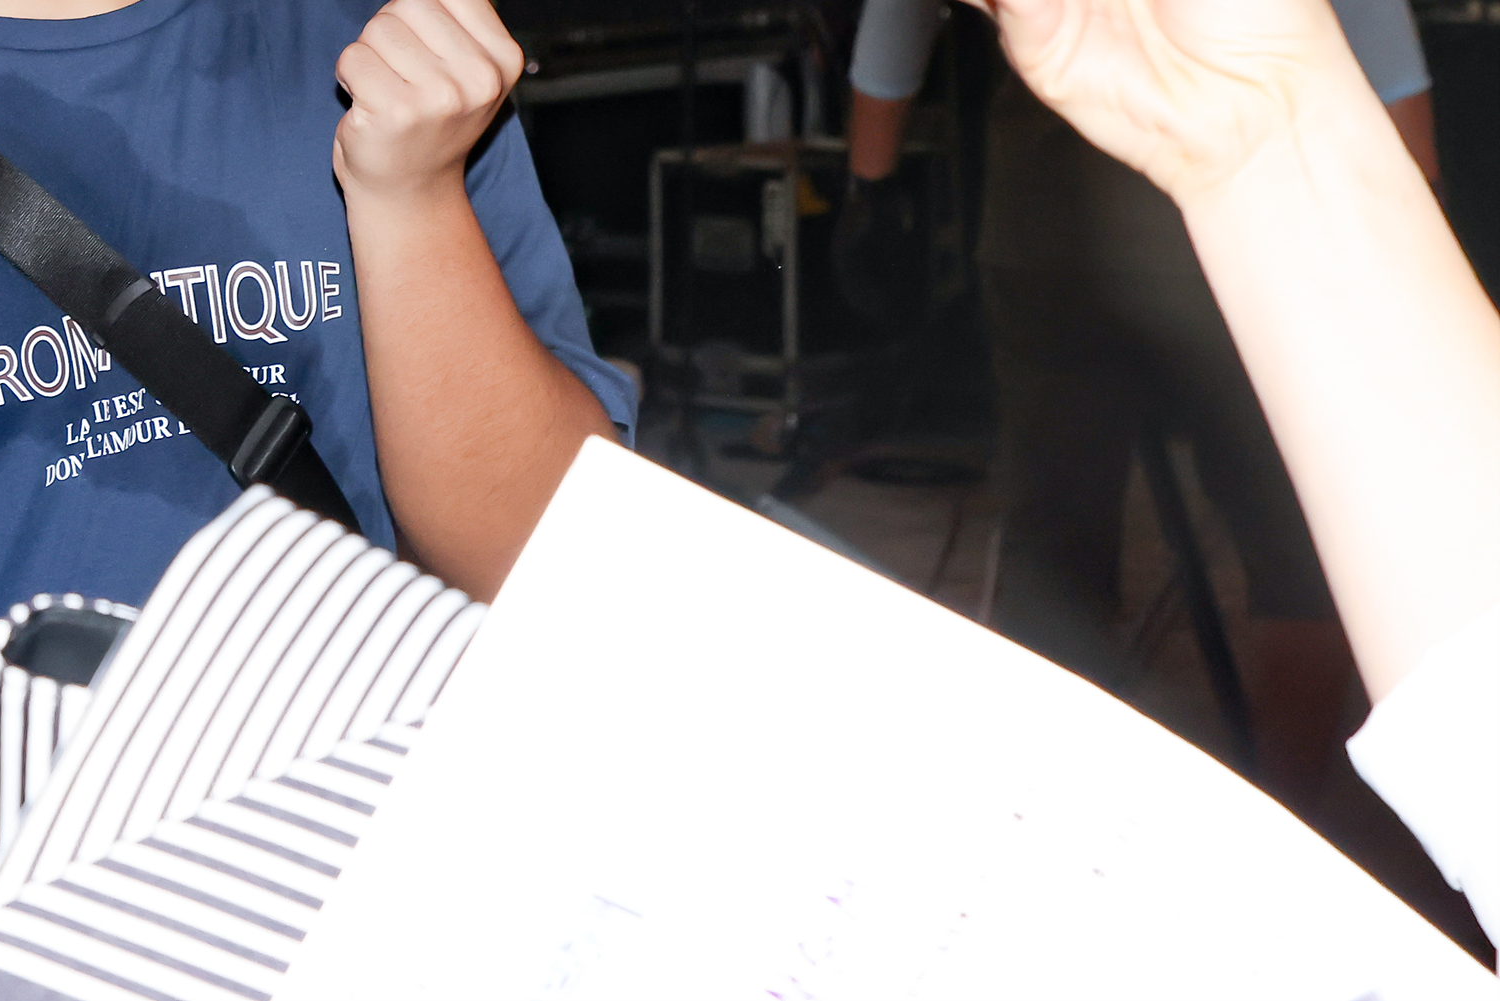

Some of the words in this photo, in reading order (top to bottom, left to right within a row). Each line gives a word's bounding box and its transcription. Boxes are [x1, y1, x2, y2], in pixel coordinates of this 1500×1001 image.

[66, 418, 91, 445] LA
[92, 399, 111, 423] IE
[45, 453, 86, 487] DON
[86, 416, 173, 459] L'AMOUR
